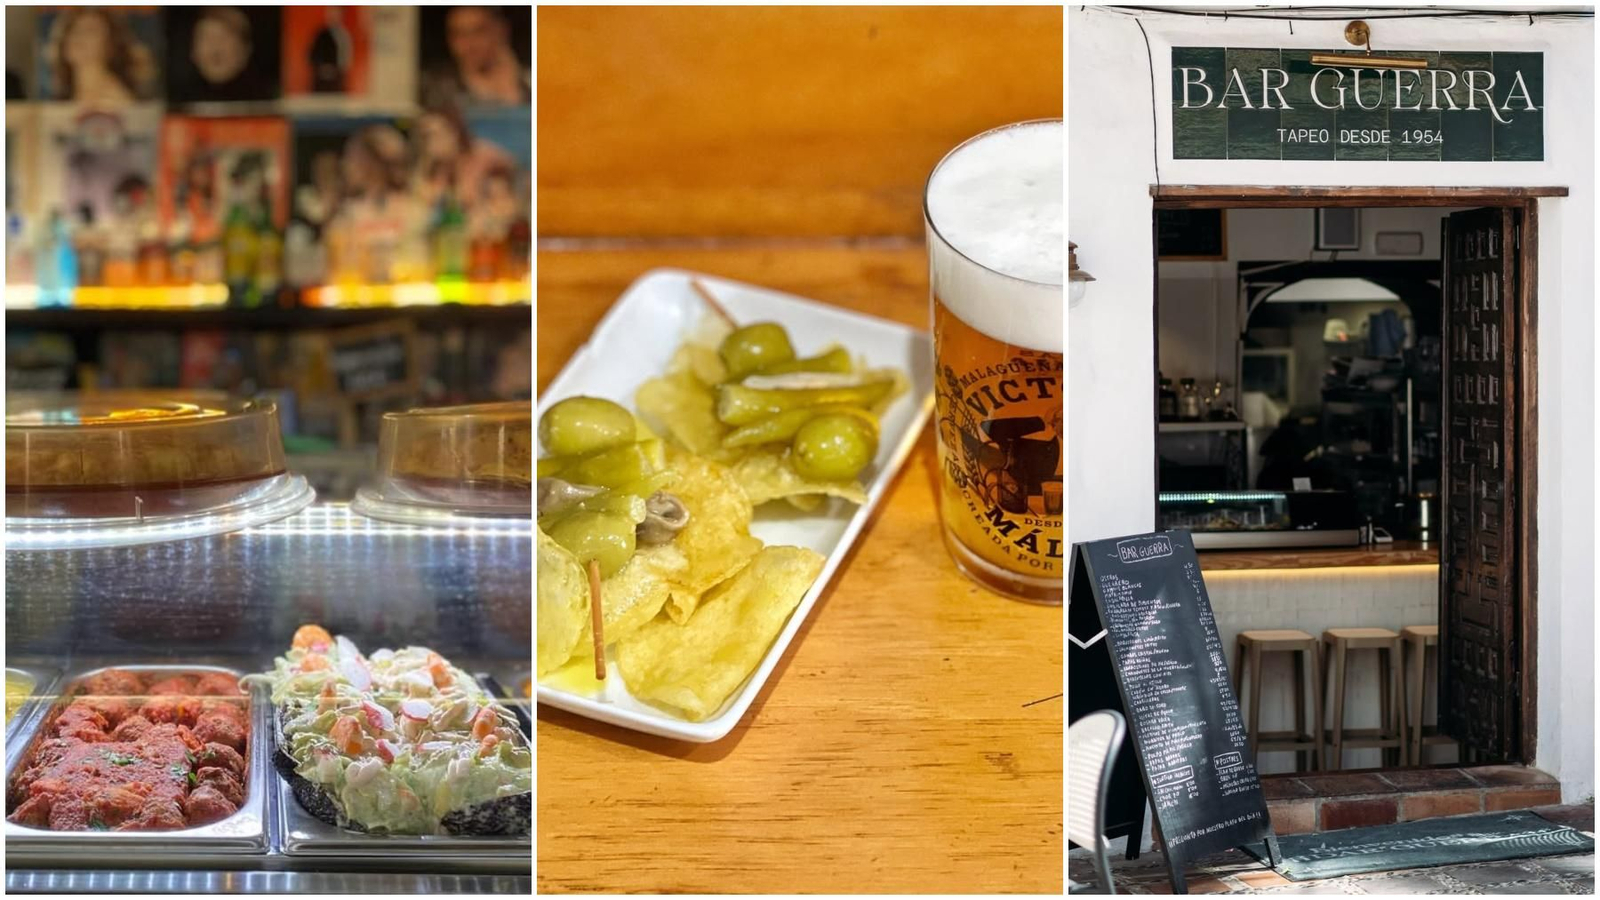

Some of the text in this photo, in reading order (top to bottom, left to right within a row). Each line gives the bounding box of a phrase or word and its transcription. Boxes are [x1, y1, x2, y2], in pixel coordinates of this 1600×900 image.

[1179, 67, 1539, 124] BAR GUERRA
[1277, 128, 1444, 144] TAPEO DESDE 1954
[966, 377, 1063, 417] VICT
[962, 489, 1054, 571] CREADA POR
[1120, 542, 1169, 559] BAR GUERRA
